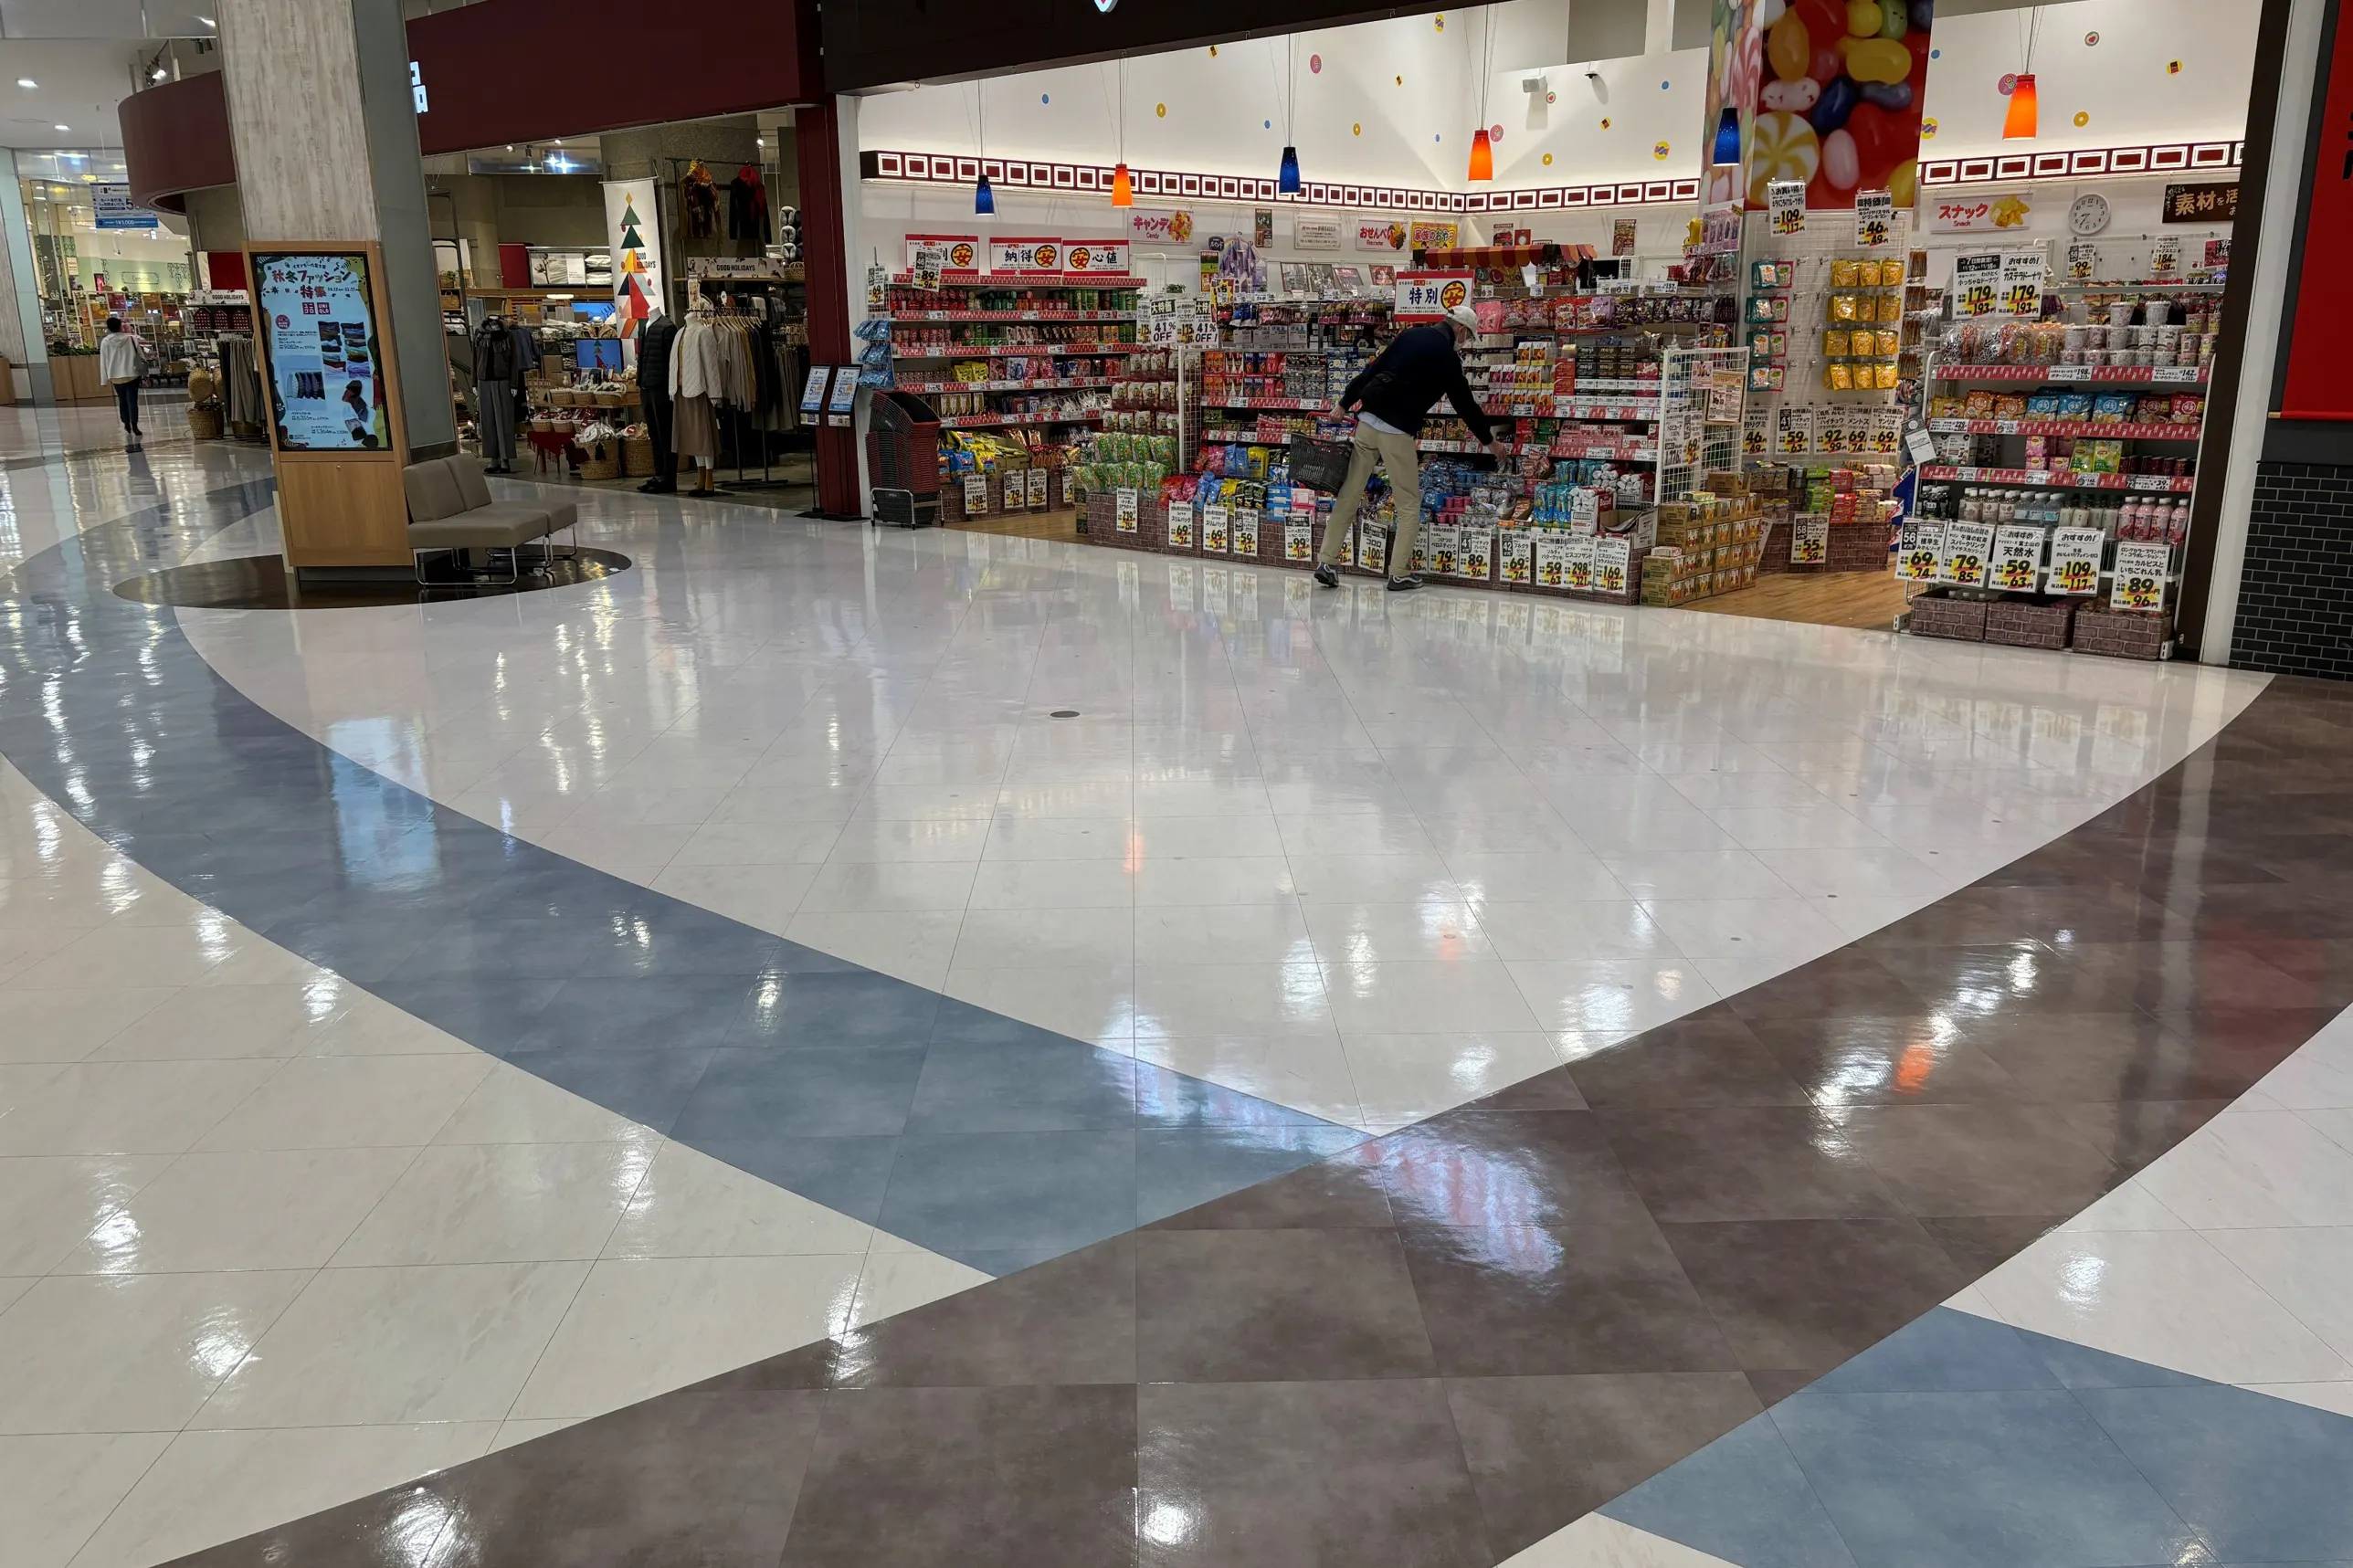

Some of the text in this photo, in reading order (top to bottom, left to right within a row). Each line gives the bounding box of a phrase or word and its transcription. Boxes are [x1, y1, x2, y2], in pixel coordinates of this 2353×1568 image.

[1938, 203, 1989, 220] スナック
[1414, 228, 1455, 244] 家族のおやつ
[1005, 249, 1033, 263] 納得
[636, 261, 656, 269] HOLIDAYS
[272, 269, 351, 284] 秋冬ファッション
[300, 285, 327, 300] 特集
[1409, 287, 1438, 305] 特別
[1151, 302, 1172, 314] 大特価
[1196, 302, 1210, 314] 大特
[1155, 322, 1176, 332] 41%
[1198, 323, 1217, 332] 41%
[1154, 332, 1172, 342] OFF
[1961, 533, 1988, 542] 午後の紅茶
[1366, 538, 1382, 548] コロロ
[1950, 539, 1986, 549] スパークリング
[2003, 546, 2034, 557] 天然水
[2135, 560, 2164, 568] カルピスと
[2120, 567, 2163, 576] いちごれん乳
